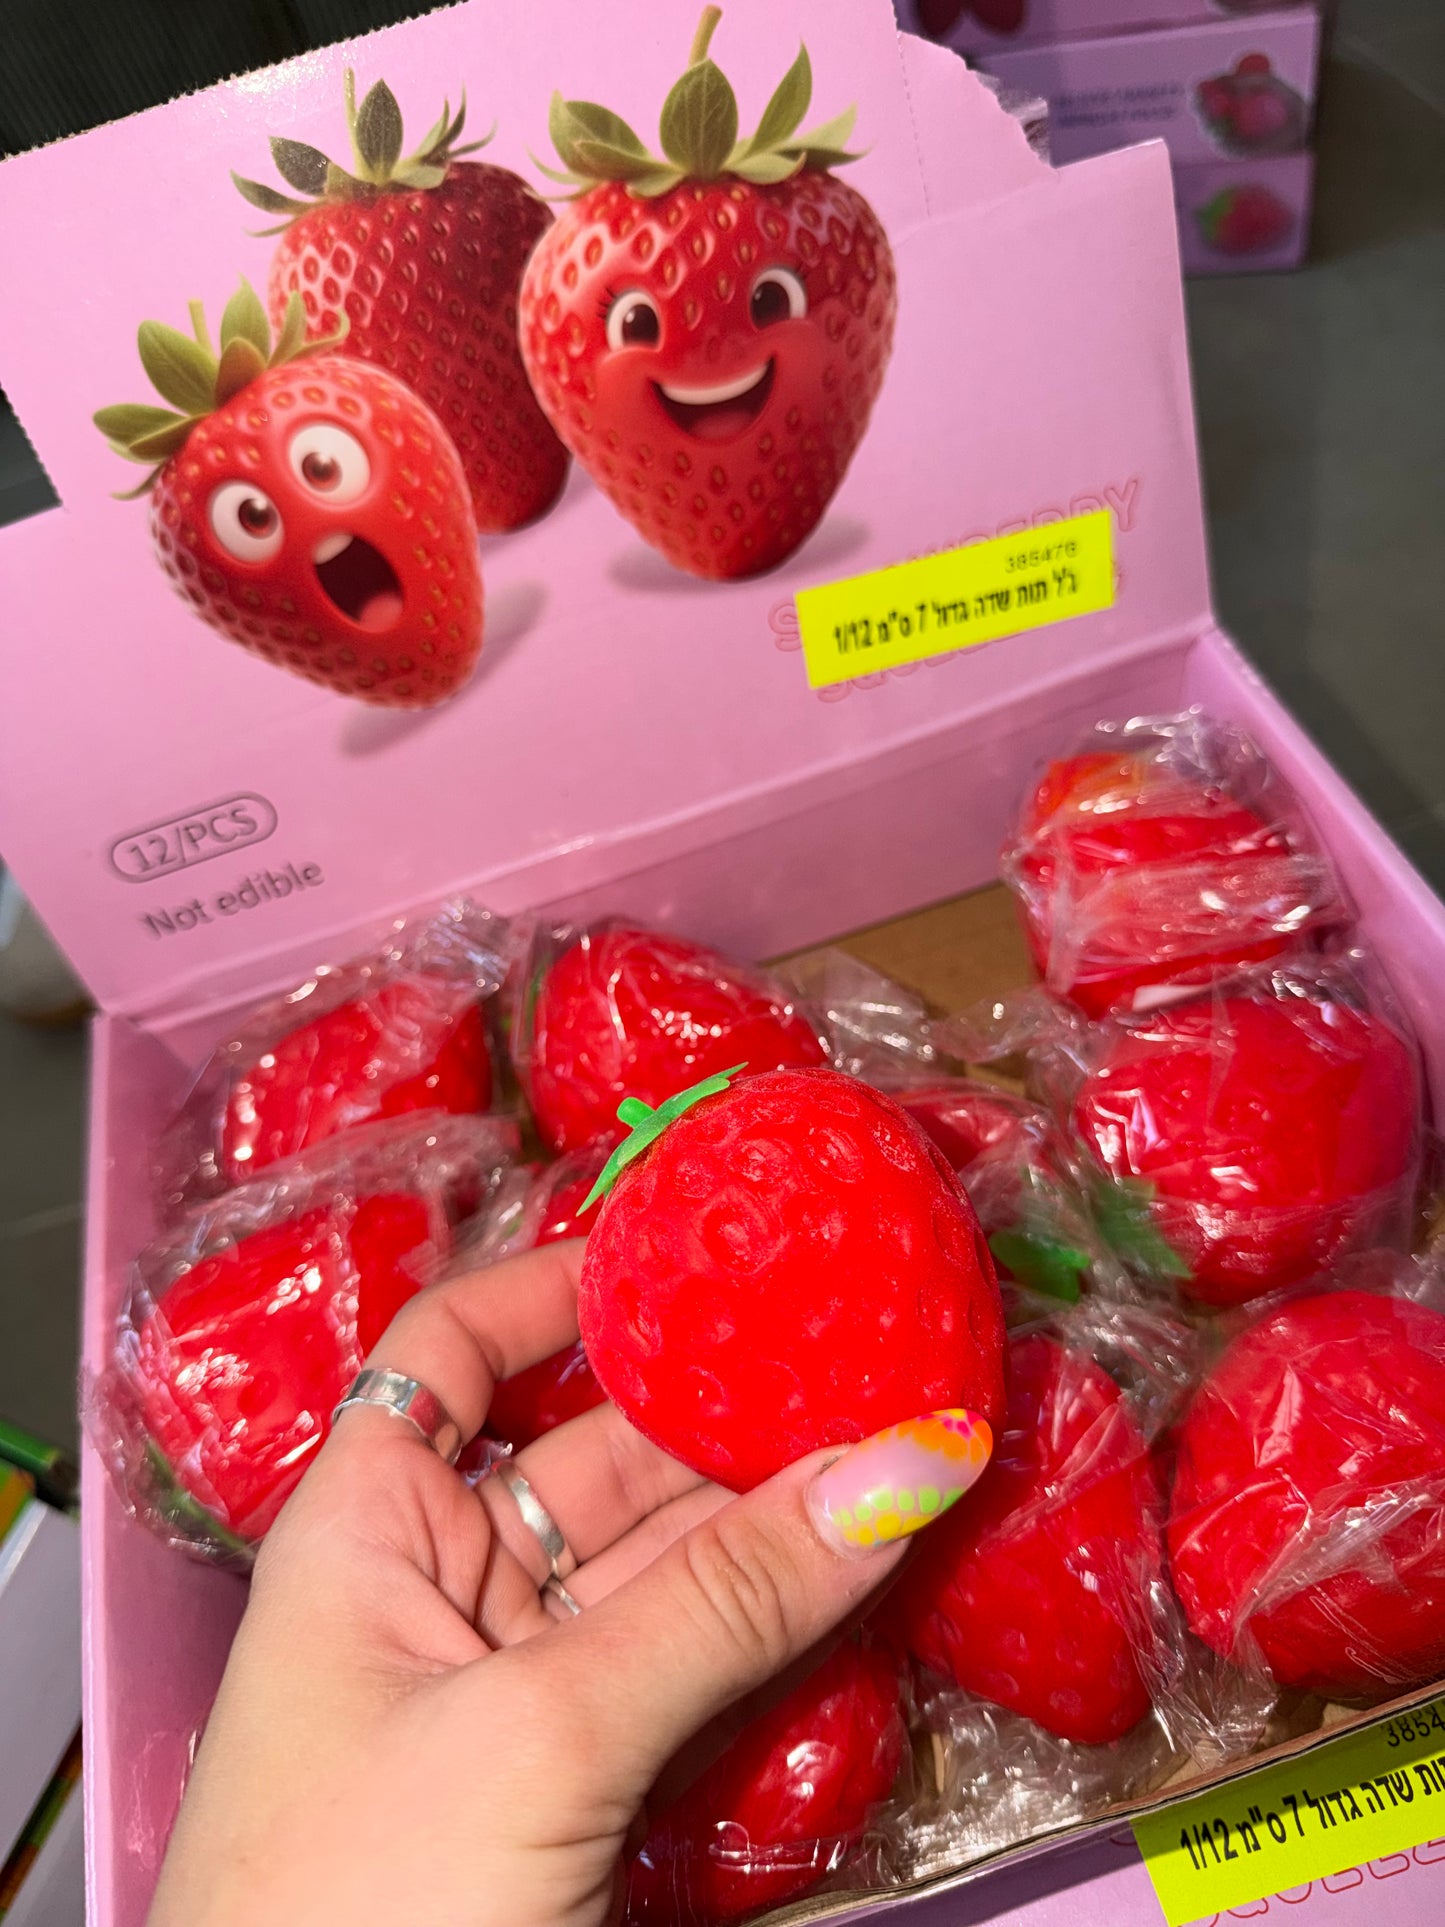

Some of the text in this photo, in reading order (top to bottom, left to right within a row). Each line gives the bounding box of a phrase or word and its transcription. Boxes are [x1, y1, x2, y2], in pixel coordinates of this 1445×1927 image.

[931, 599, 969, 628] גדול
[973, 589, 1010, 619] שדה
[1016, 579, 1047, 608] תות
[834, 618, 873, 655] 1/12
[914, 603, 927, 633] 7
[129, 804, 258, 873] 12/PCS
[142, 861, 324, 941] Not edible
[1385, 1707, 1445, 1748] 3854
[1302, 1787, 1364, 1830] גדול
[1358, 1769, 1414, 1811] שדה
[1237, 1805, 1288, 1855] ס"מ
[1282, 1794, 1306, 1838] 7
[1180, 1817, 1239, 1870] 1/12
